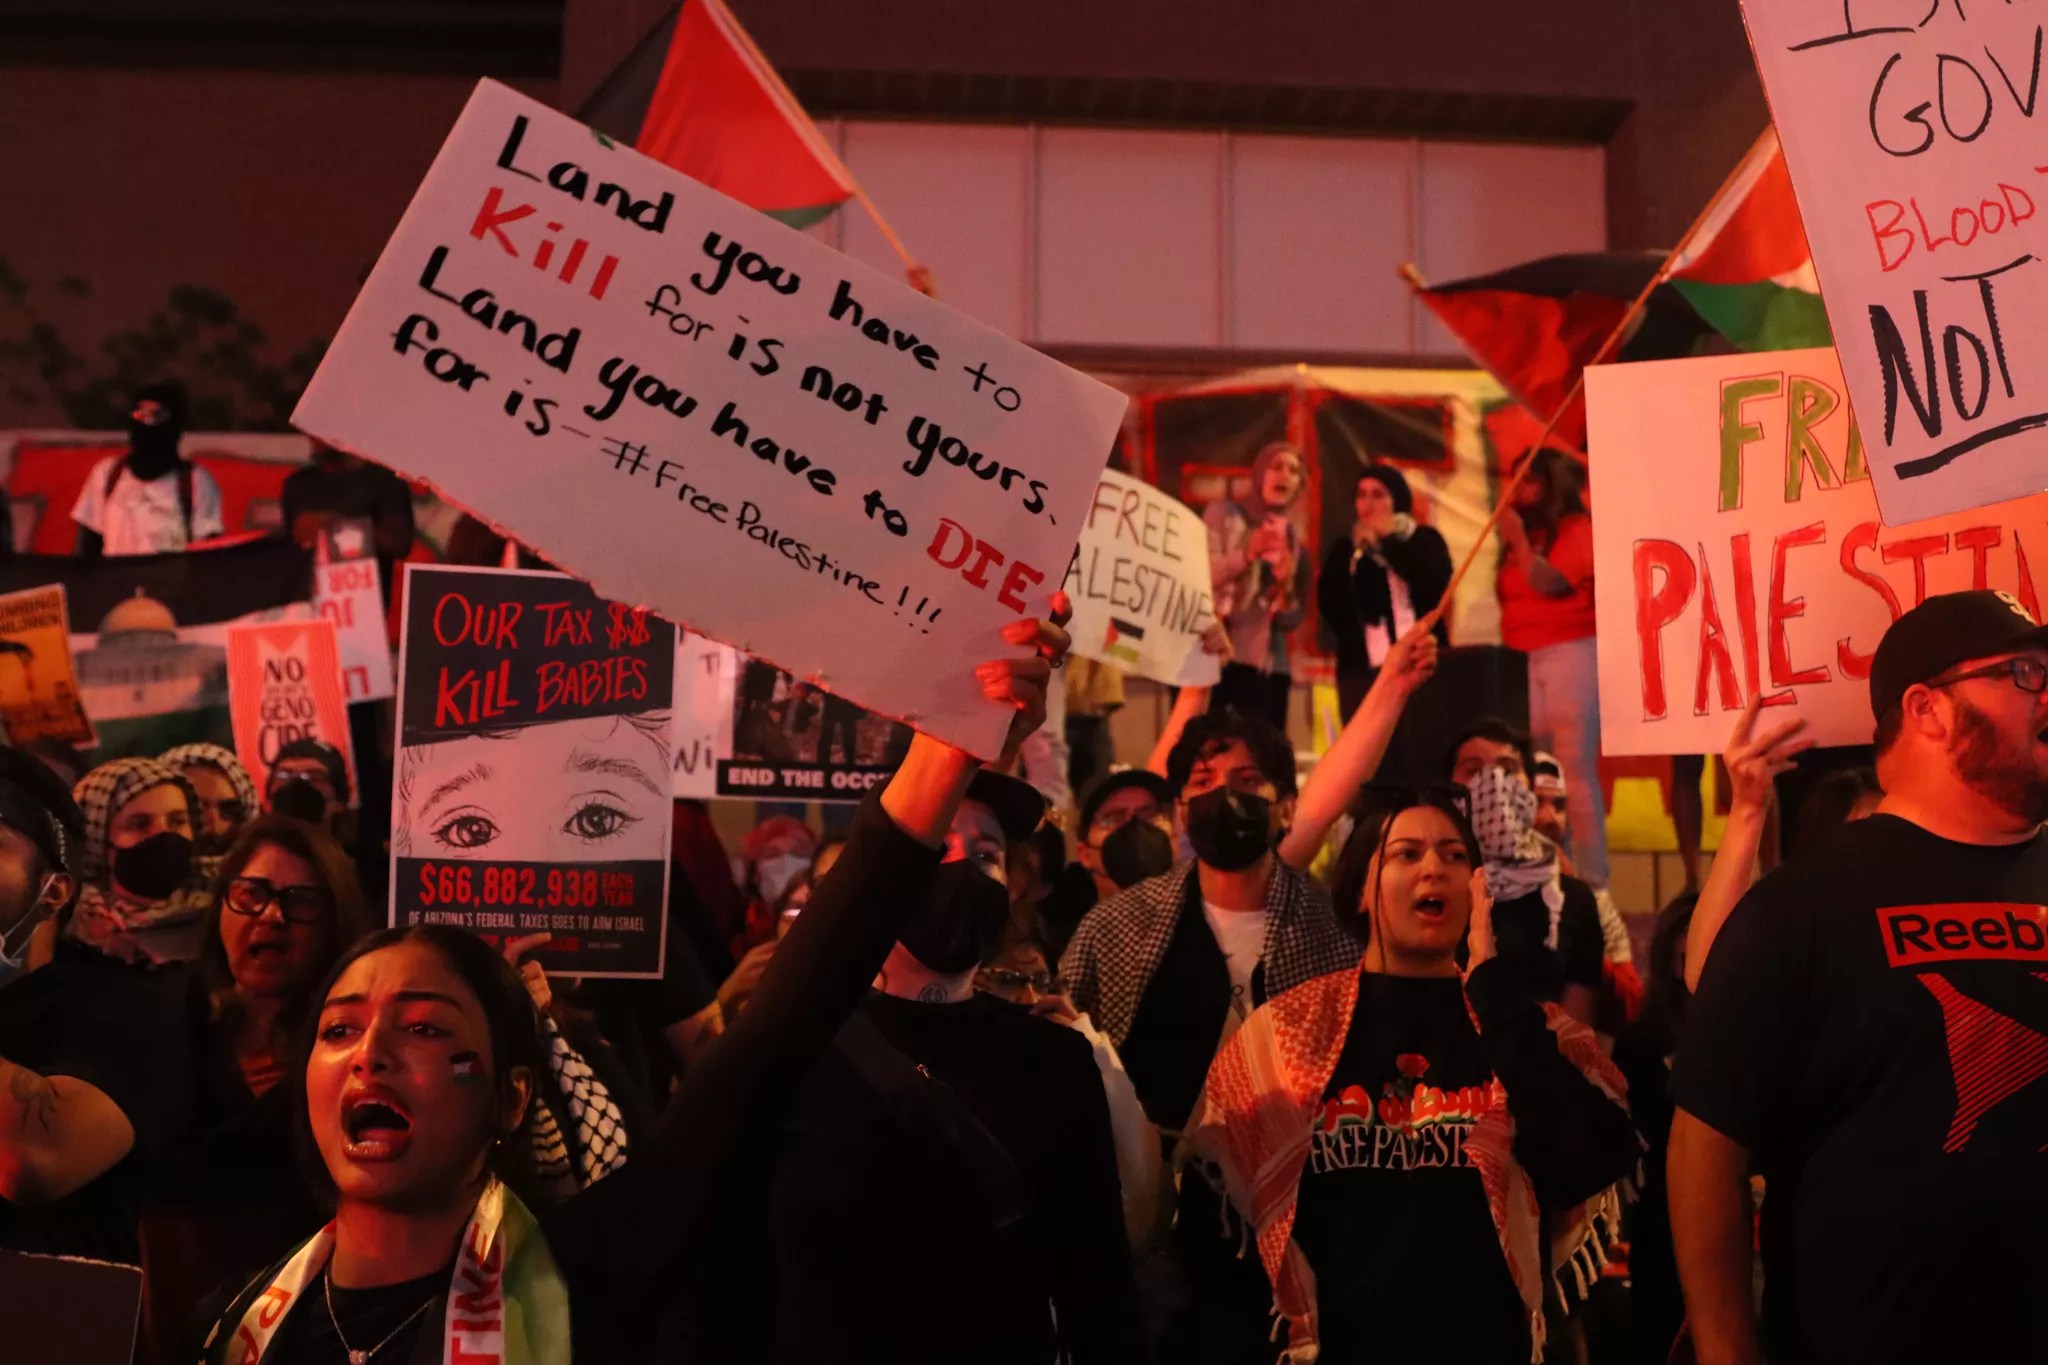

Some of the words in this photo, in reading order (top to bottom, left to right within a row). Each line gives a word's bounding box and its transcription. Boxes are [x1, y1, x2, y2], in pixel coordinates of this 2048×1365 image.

[497, 115, 675, 233] Land
[691, 232, 800, 295] you
[829, 280, 940, 371] have
[963, 363, 1021, 412] to
[470, 187, 619, 301] Kill
[645, 285, 714, 341] for
[728, 315, 784, 376] is
[800, 366, 887, 425] not
[390, 314, 490, 392] for
[1868, 254, 2038, 448] NOT
[419, 246, 581, 374] Land
[583, 357, 698, 422] you
[710, 402, 838, 496] have
[864, 489, 908, 537] to
[926, 517, 1045, 615] DIE
[1088, 481, 1181, 563] FREE
[433, 592, 523, 650] OUR
[535, 601, 592, 647] TAX
[264, 656, 305, 684] NO
[435, 659, 520, 727] KILL
[535, 655, 649, 714] BABIES
[261, 697, 315, 723] GENO
[727, 766, 775, 786] END
[780, 768, 824, 788] THE
[831, 770, 893, 790] OCC
[419, 862, 598, 908] $66,882,938
[408, 911, 420, 926] OF
[424, 911, 473, 926] ARIZONA'S
[476, 912, 515, 928] FEDERAL
[520, 914, 549, 929] TAXES
[552, 915, 574, 930] GOES
[577, 915, 590, 930] TO
[592, 916, 613, 930] ARM
[615, 916, 645, 932] ISRAEL
[1888, 911, 2048, 955] Reeb
[1311, 1124, 1369, 1174] FREE
